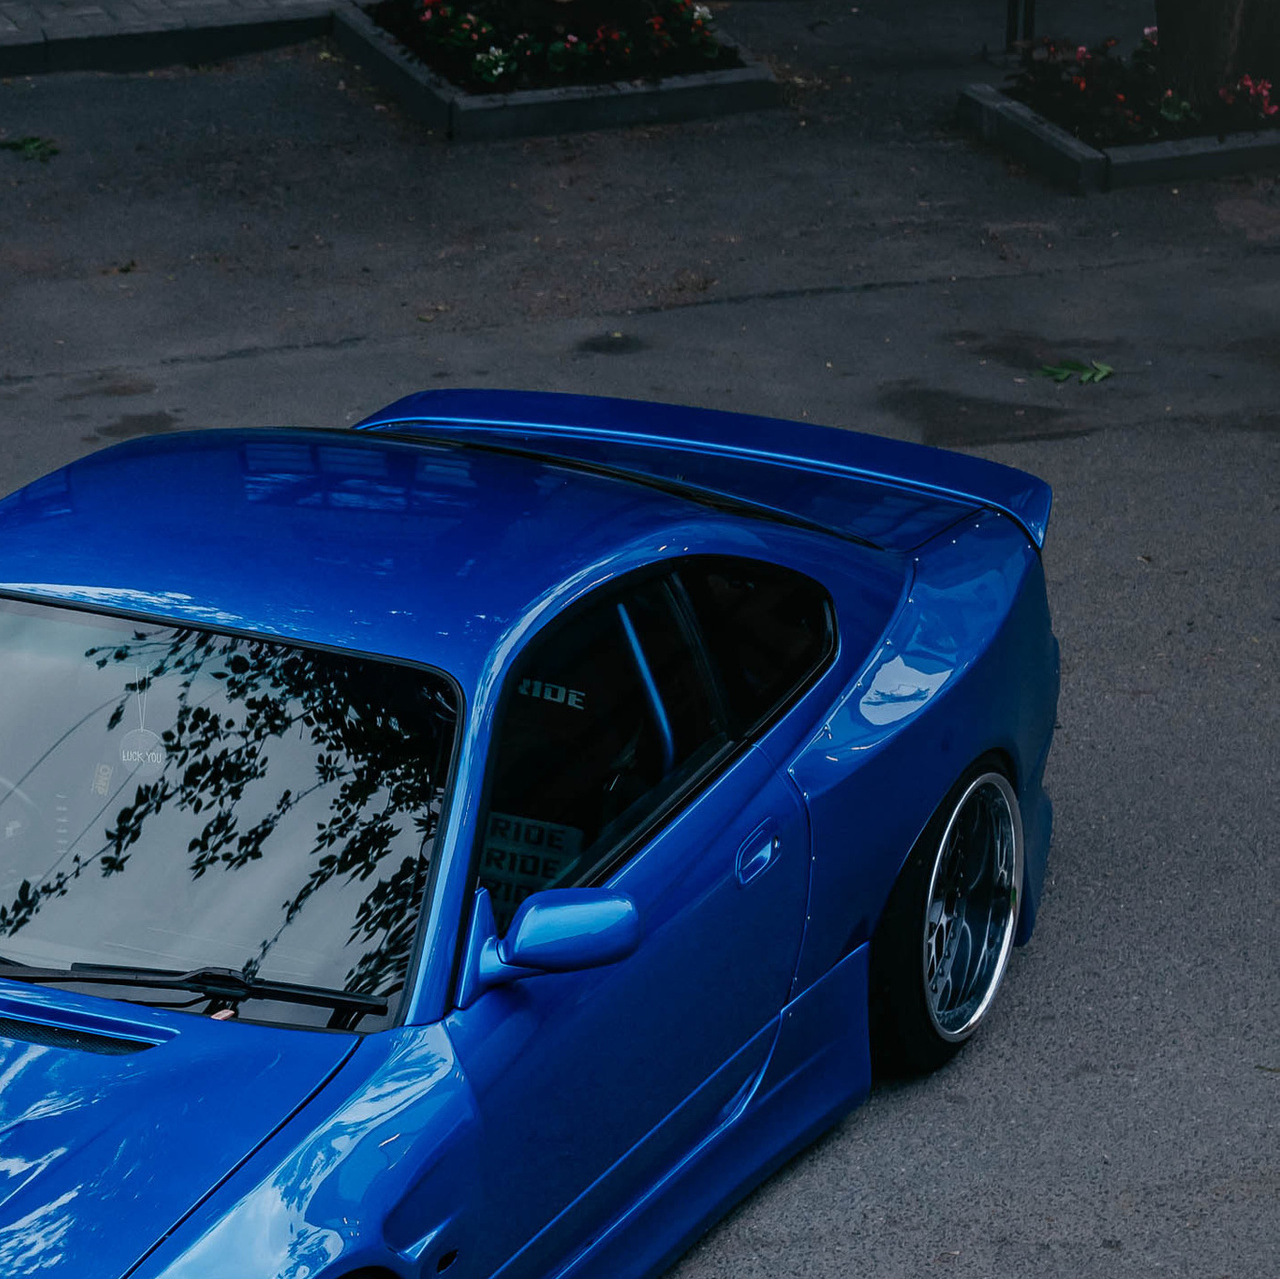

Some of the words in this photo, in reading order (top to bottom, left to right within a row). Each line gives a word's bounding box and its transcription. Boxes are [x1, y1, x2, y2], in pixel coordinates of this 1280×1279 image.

[122, 749, 145, 762] LUCK
[145, 751, 162, 764] YOU
[491, 817, 566, 849] RIDE
[485, 847, 560, 879] RIDE
